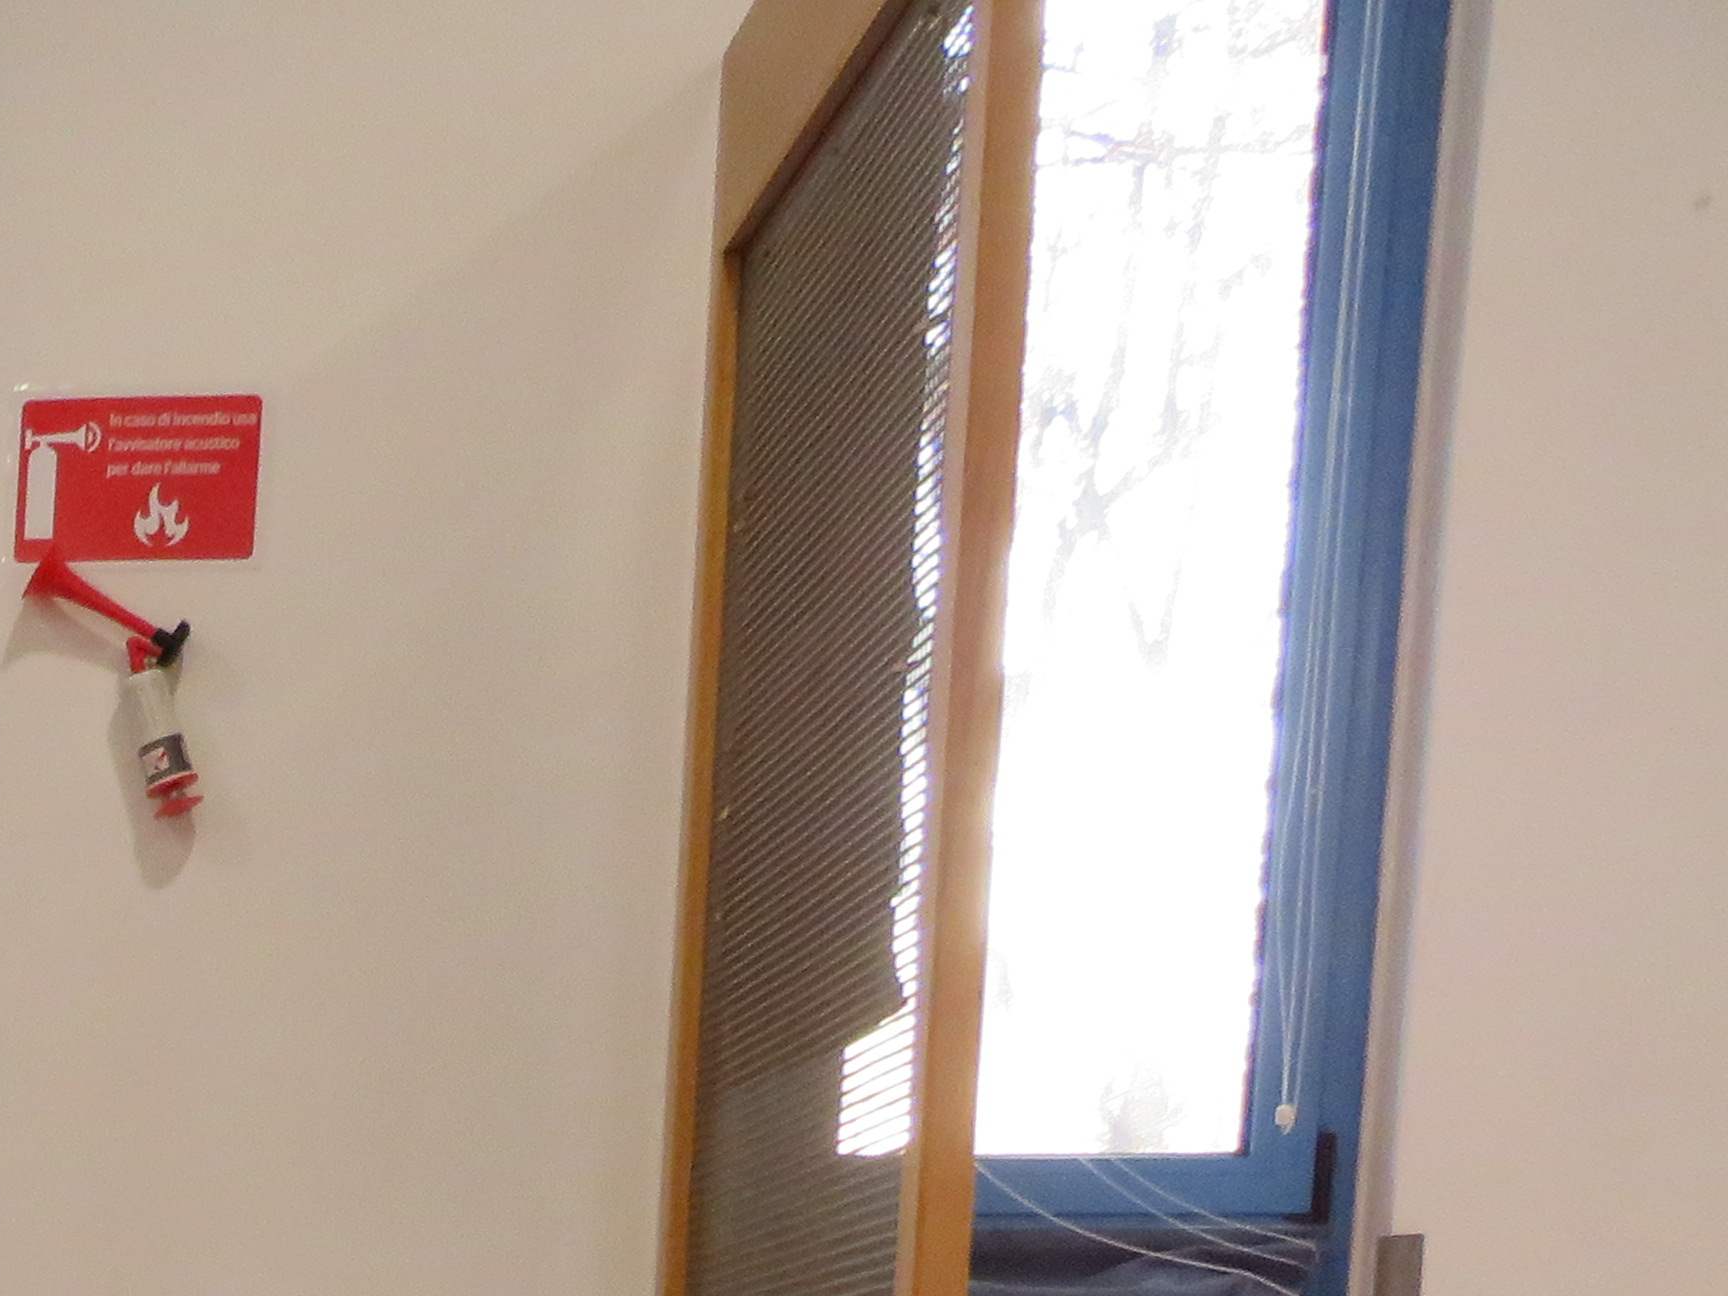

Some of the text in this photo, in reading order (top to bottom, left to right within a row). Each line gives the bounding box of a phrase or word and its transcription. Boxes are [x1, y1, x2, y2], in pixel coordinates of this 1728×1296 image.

[110, 413, 122, 427] In
[124, 414, 155, 428] caso
[157, 413, 171, 426] di
[173, 412, 231, 426] incendio
[184, 437, 240, 450] acustico
[106, 462, 221, 478] per dare l'allarme
